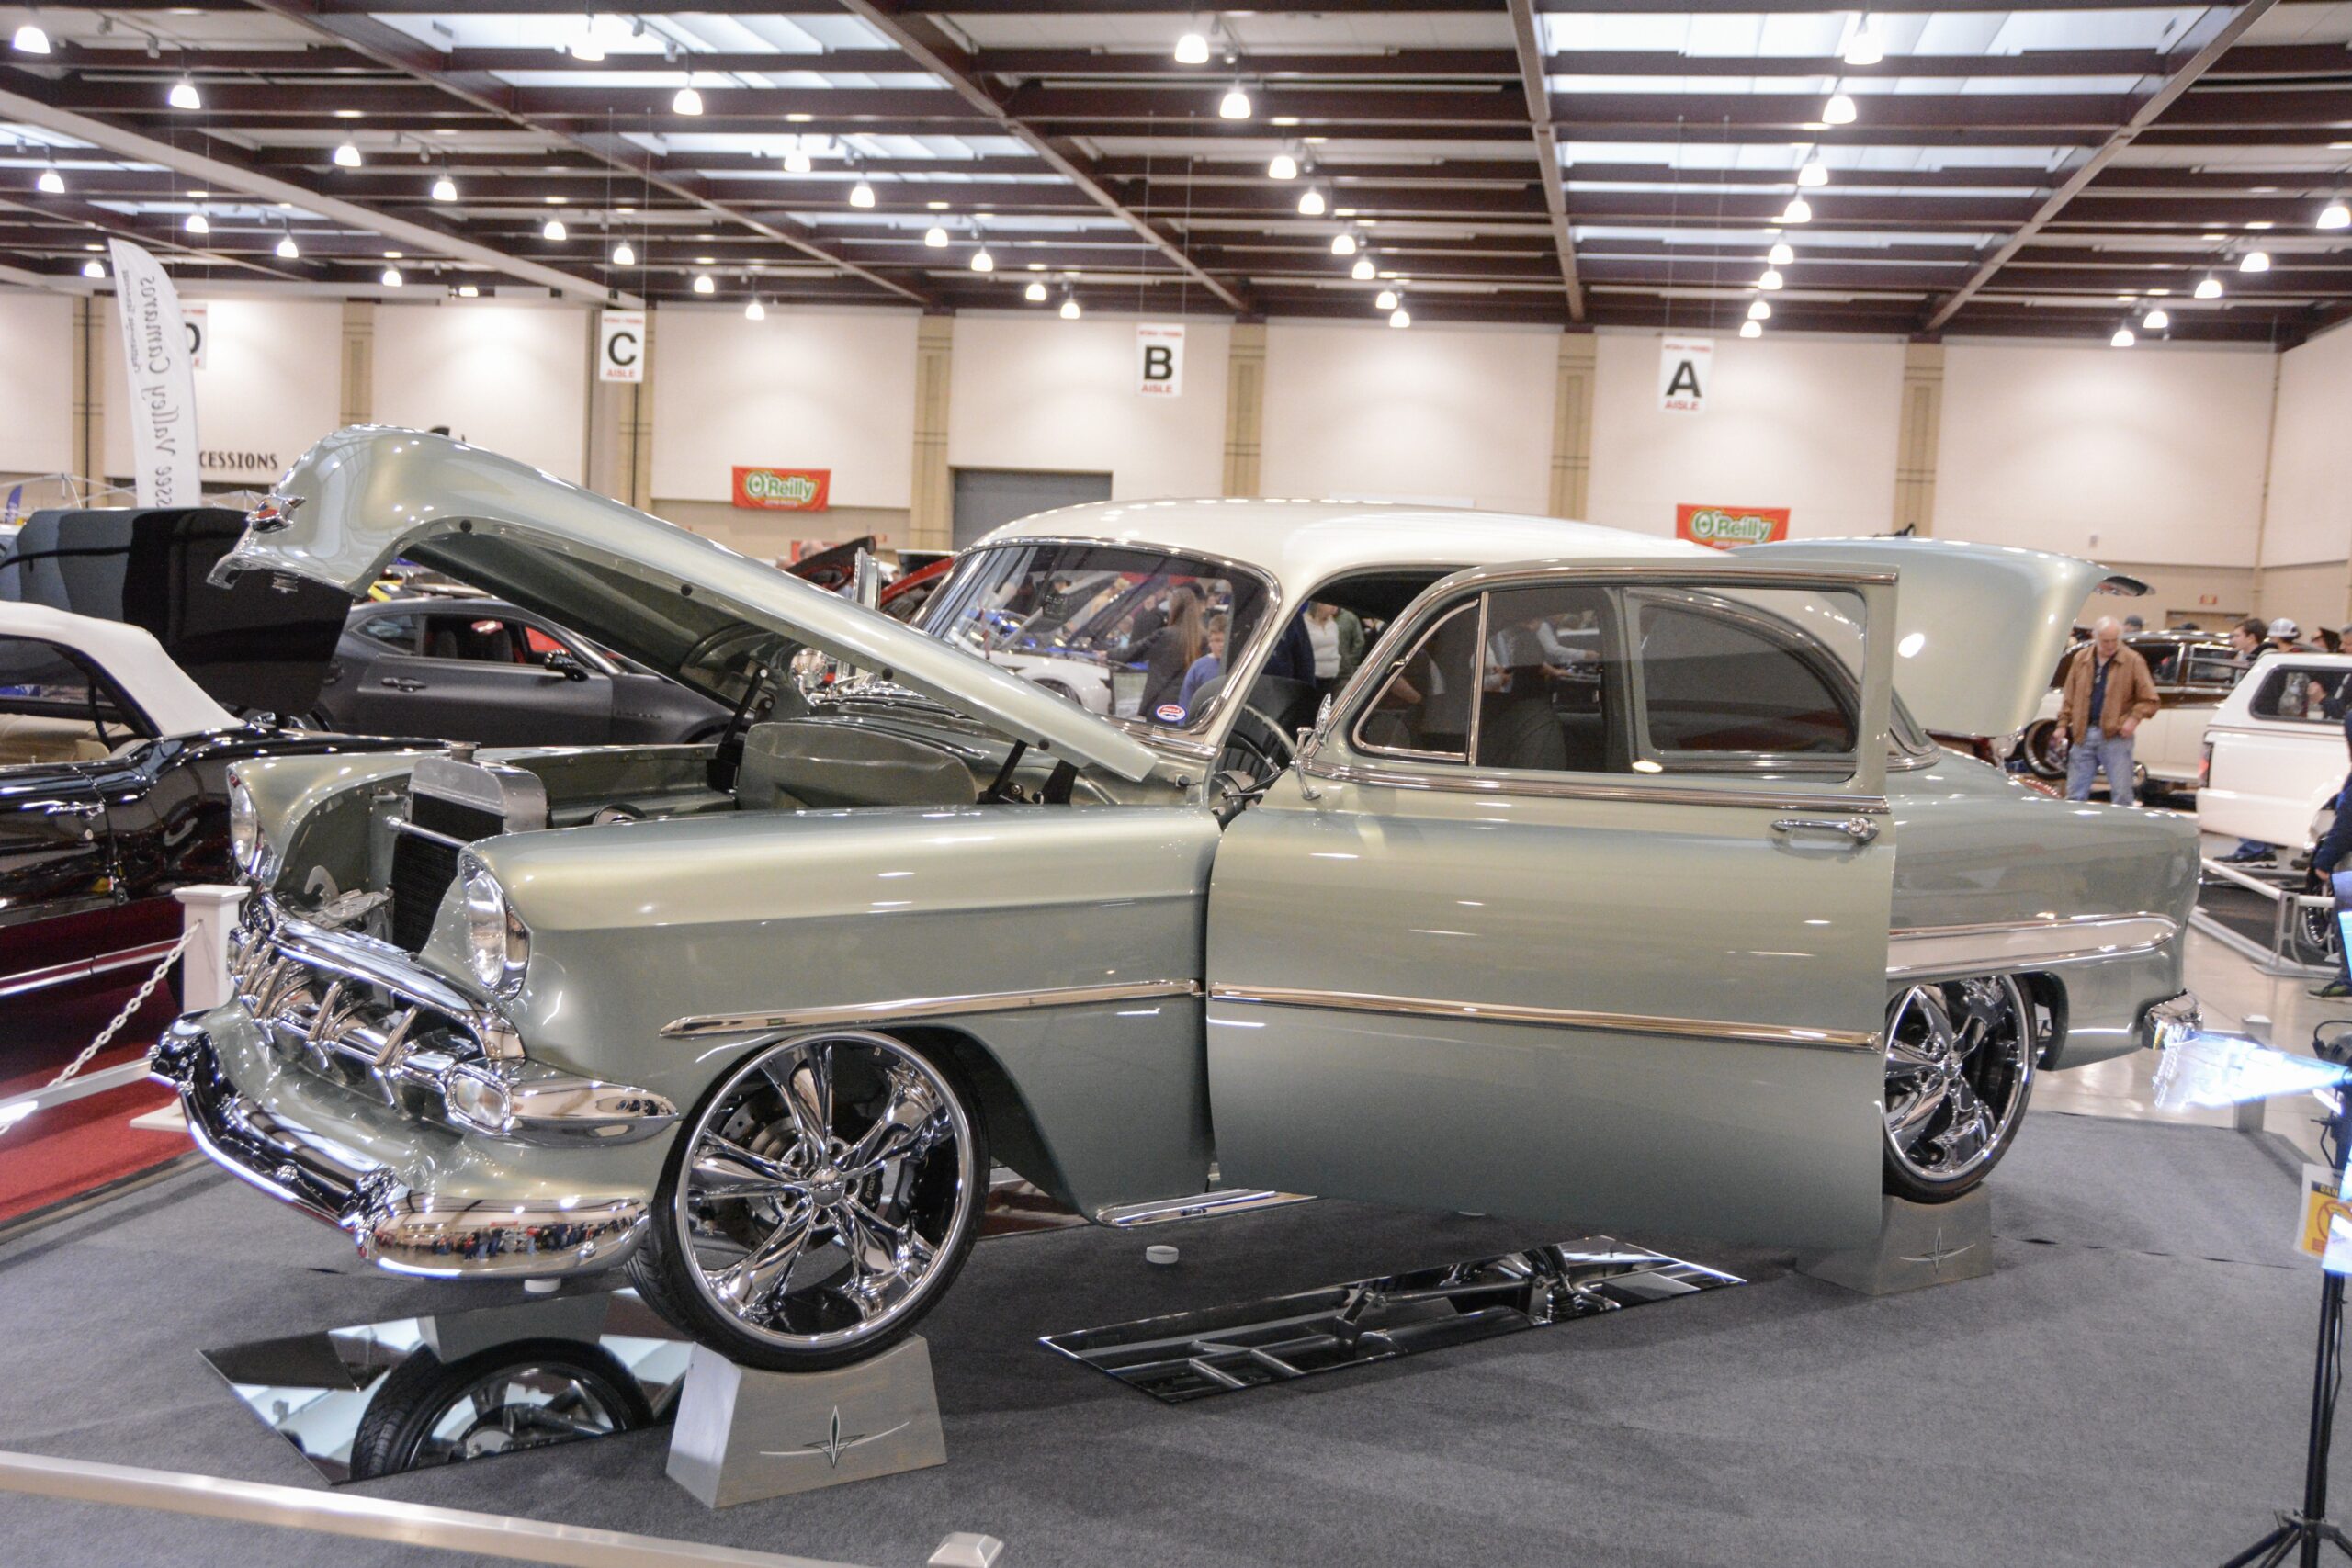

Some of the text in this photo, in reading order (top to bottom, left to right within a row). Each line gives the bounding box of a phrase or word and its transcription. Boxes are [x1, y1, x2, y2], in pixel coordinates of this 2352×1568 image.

[608, 332, 637, 366] C
[1144, 345, 1173, 380] B
[606, 368, 635, 378] AISLE
[1141, 384, 1173, 393] AISLE
[1666, 360, 1702, 397] A
[747, 471, 816, 502] O'Reilly
[1692, 511, 1773, 543] O'Reilly
